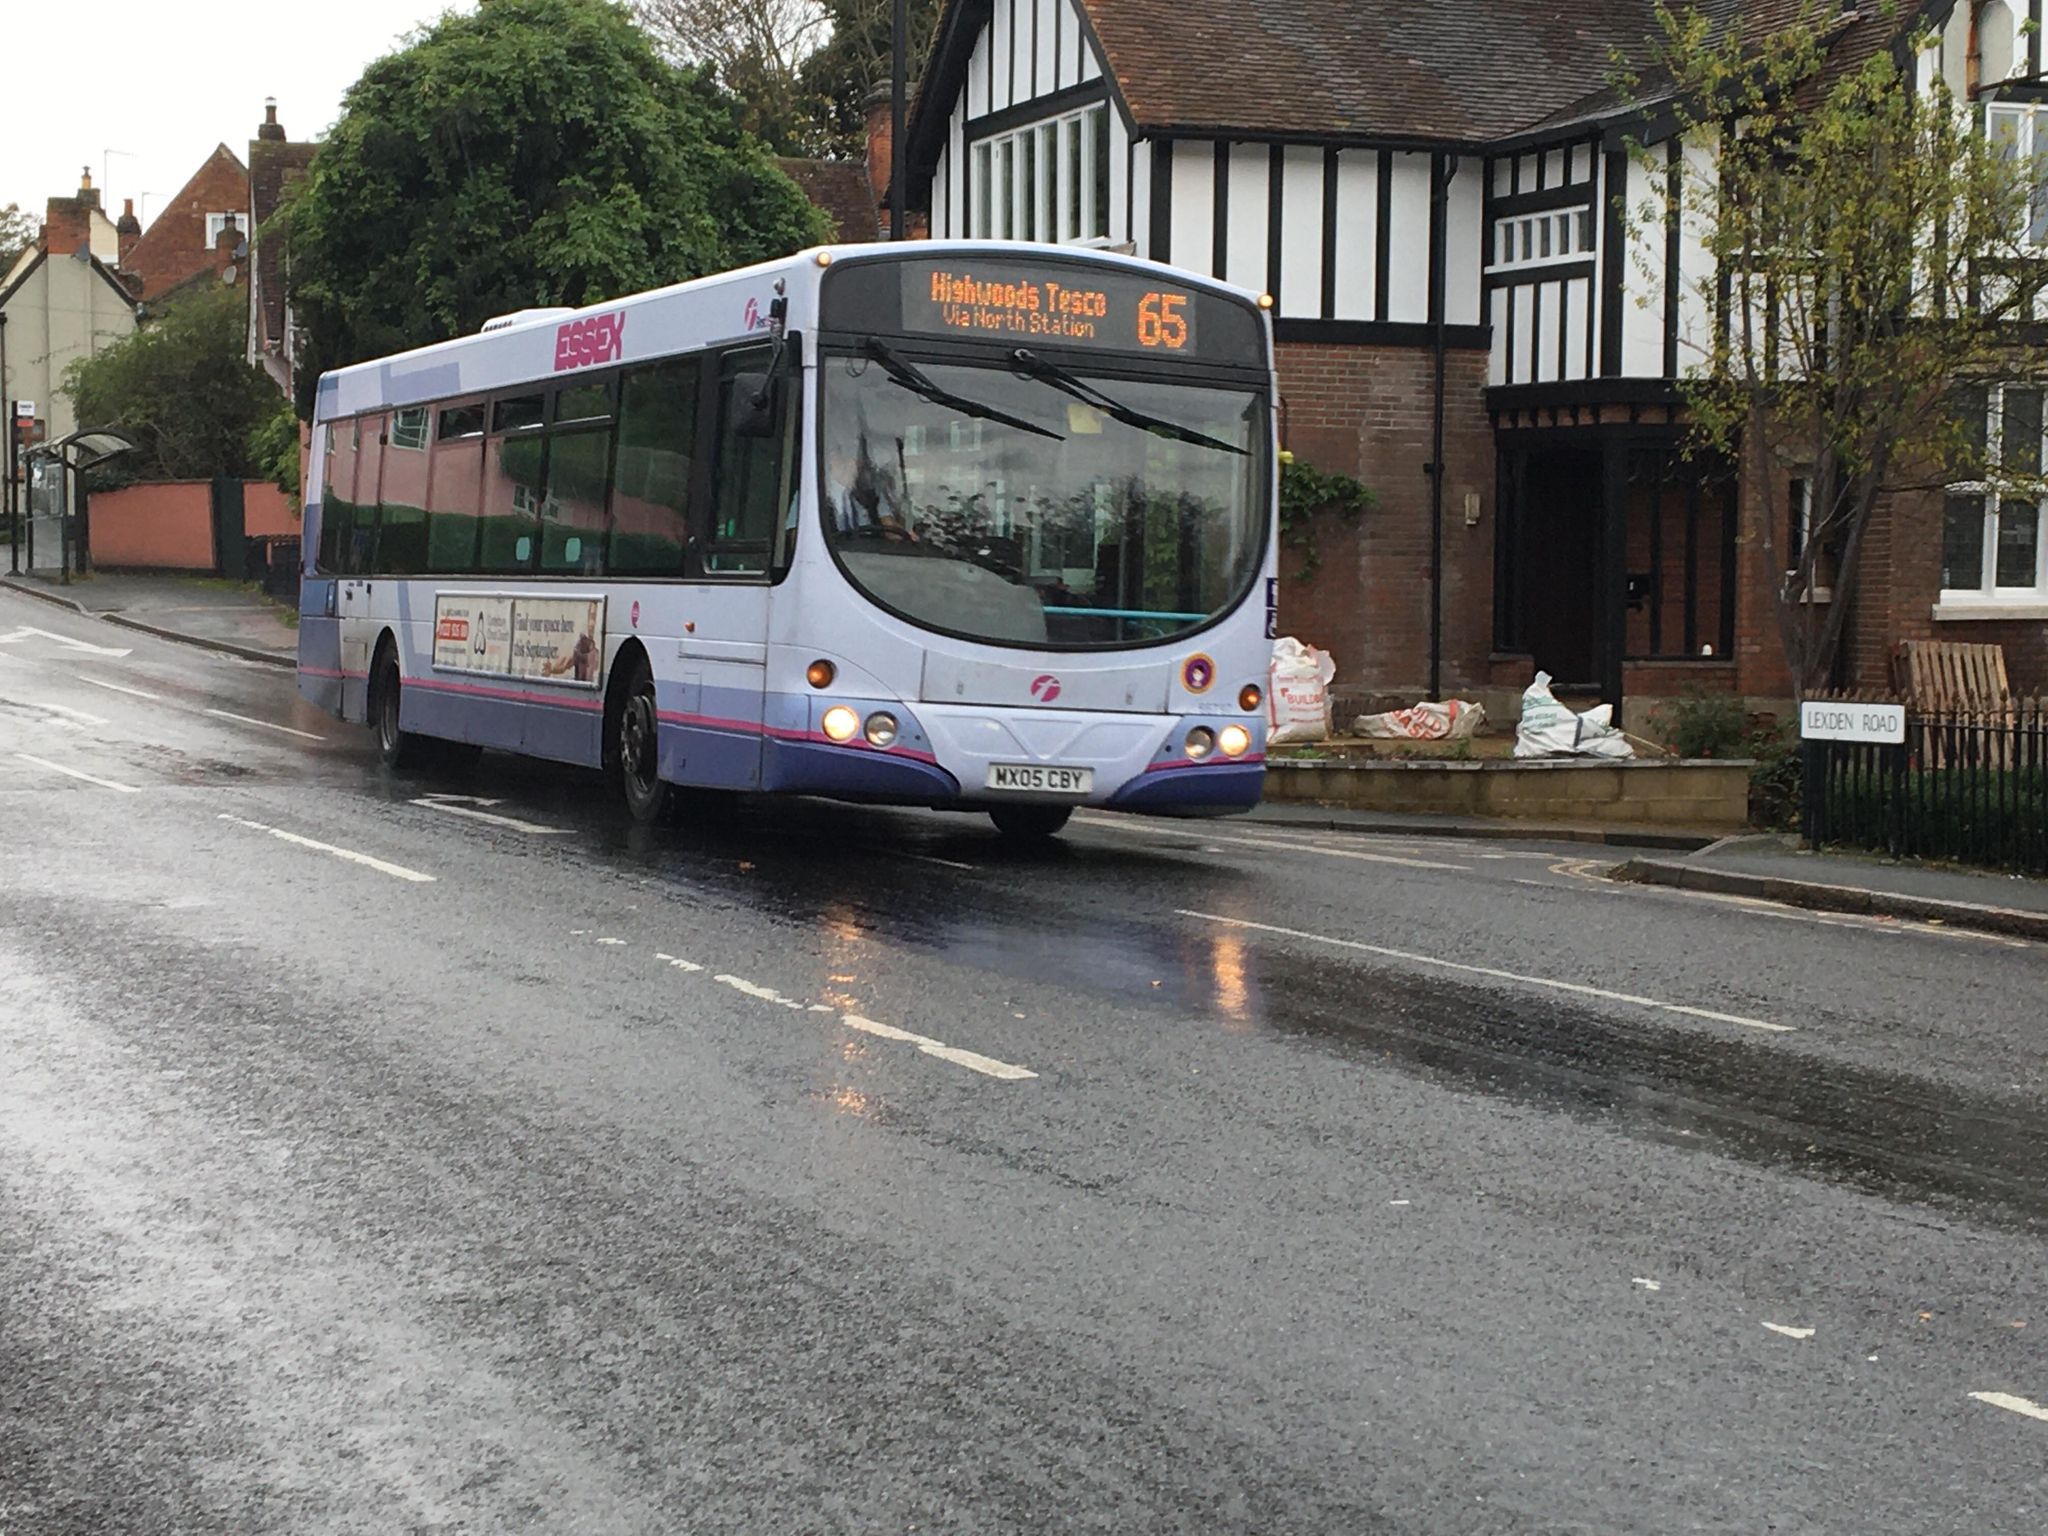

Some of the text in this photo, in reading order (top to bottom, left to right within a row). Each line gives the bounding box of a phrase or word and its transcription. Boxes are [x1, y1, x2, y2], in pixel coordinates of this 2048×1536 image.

[931, 272, 1106, 317] Highwoods Tesco
[943, 304, 1095, 338] Via North Station
[1137, 293, 1187, 347] 65
[554, 311, 626, 371] ESSEX
[1807, 711, 1898, 733] LEXDEN ROAD
[996, 767, 1083, 790] MX05 CBY
